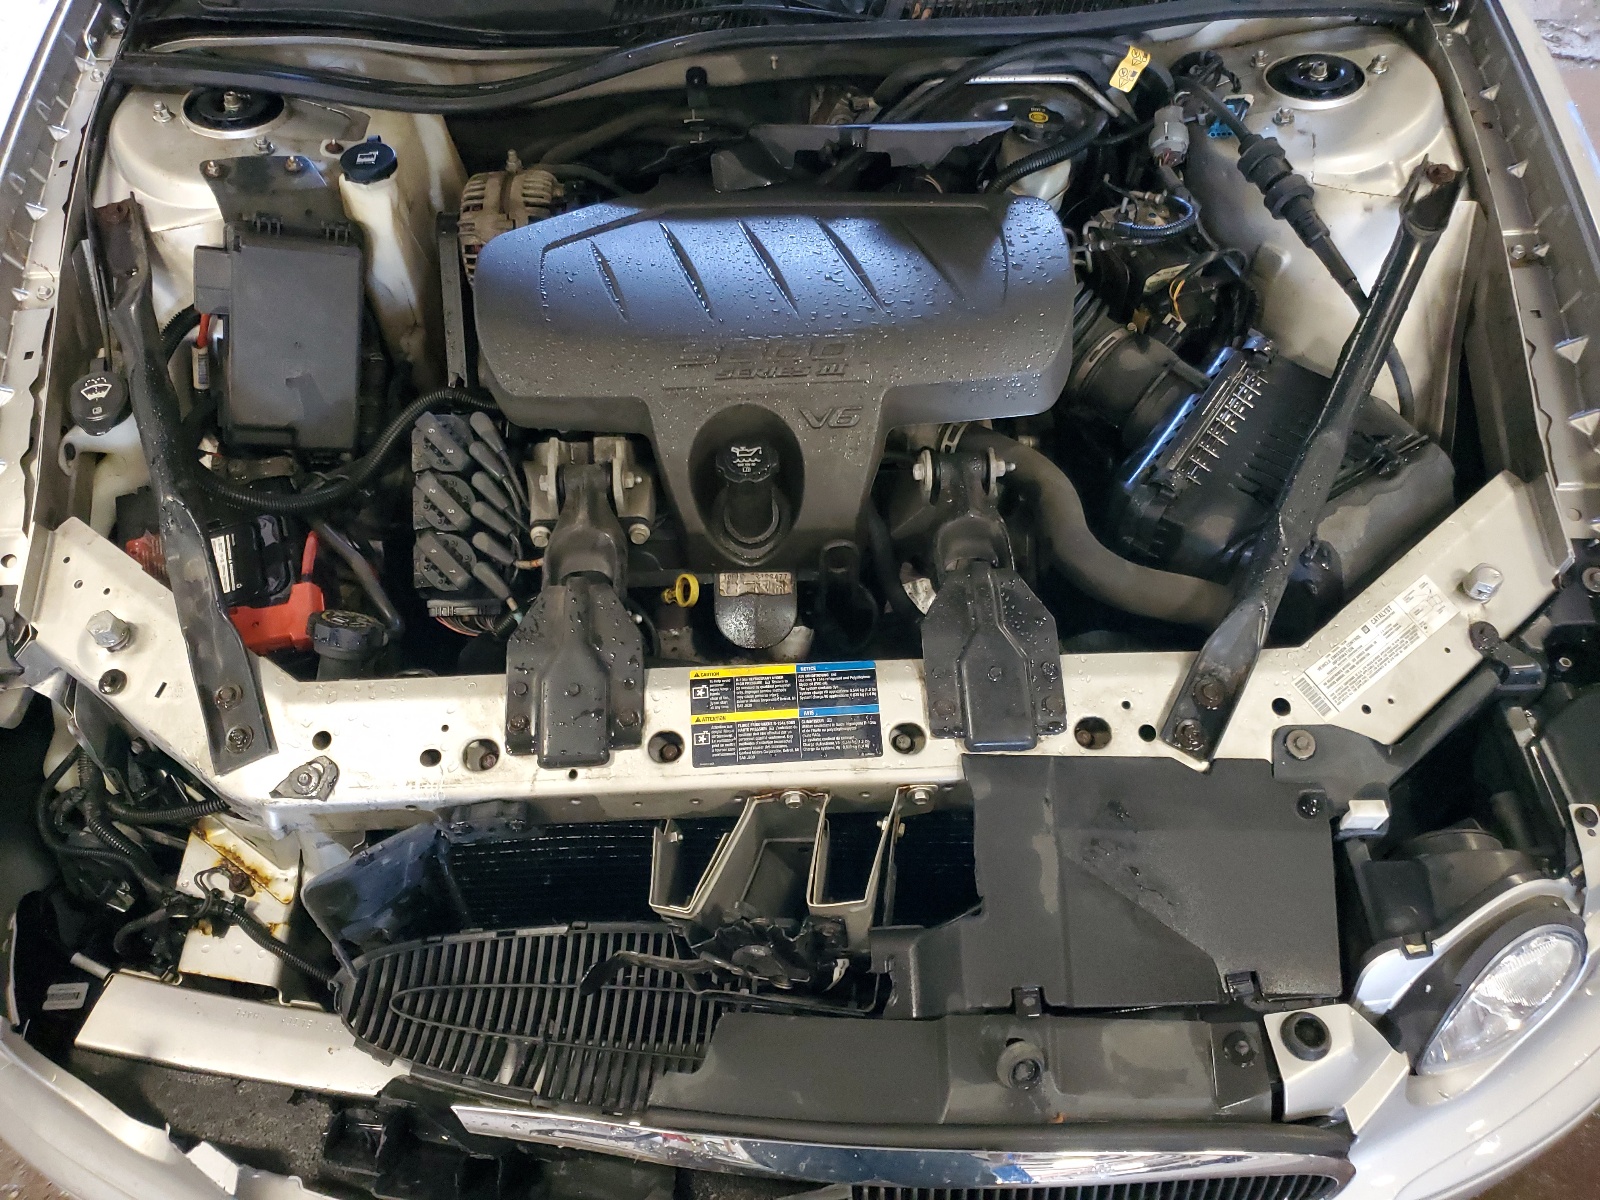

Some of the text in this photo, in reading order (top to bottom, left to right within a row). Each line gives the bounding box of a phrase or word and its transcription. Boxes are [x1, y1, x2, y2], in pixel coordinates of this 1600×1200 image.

[714, 366, 811, 381] SERIES
[800, 405, 863, 429] V6
[1370, 605, 1393, 626] CATALYST
